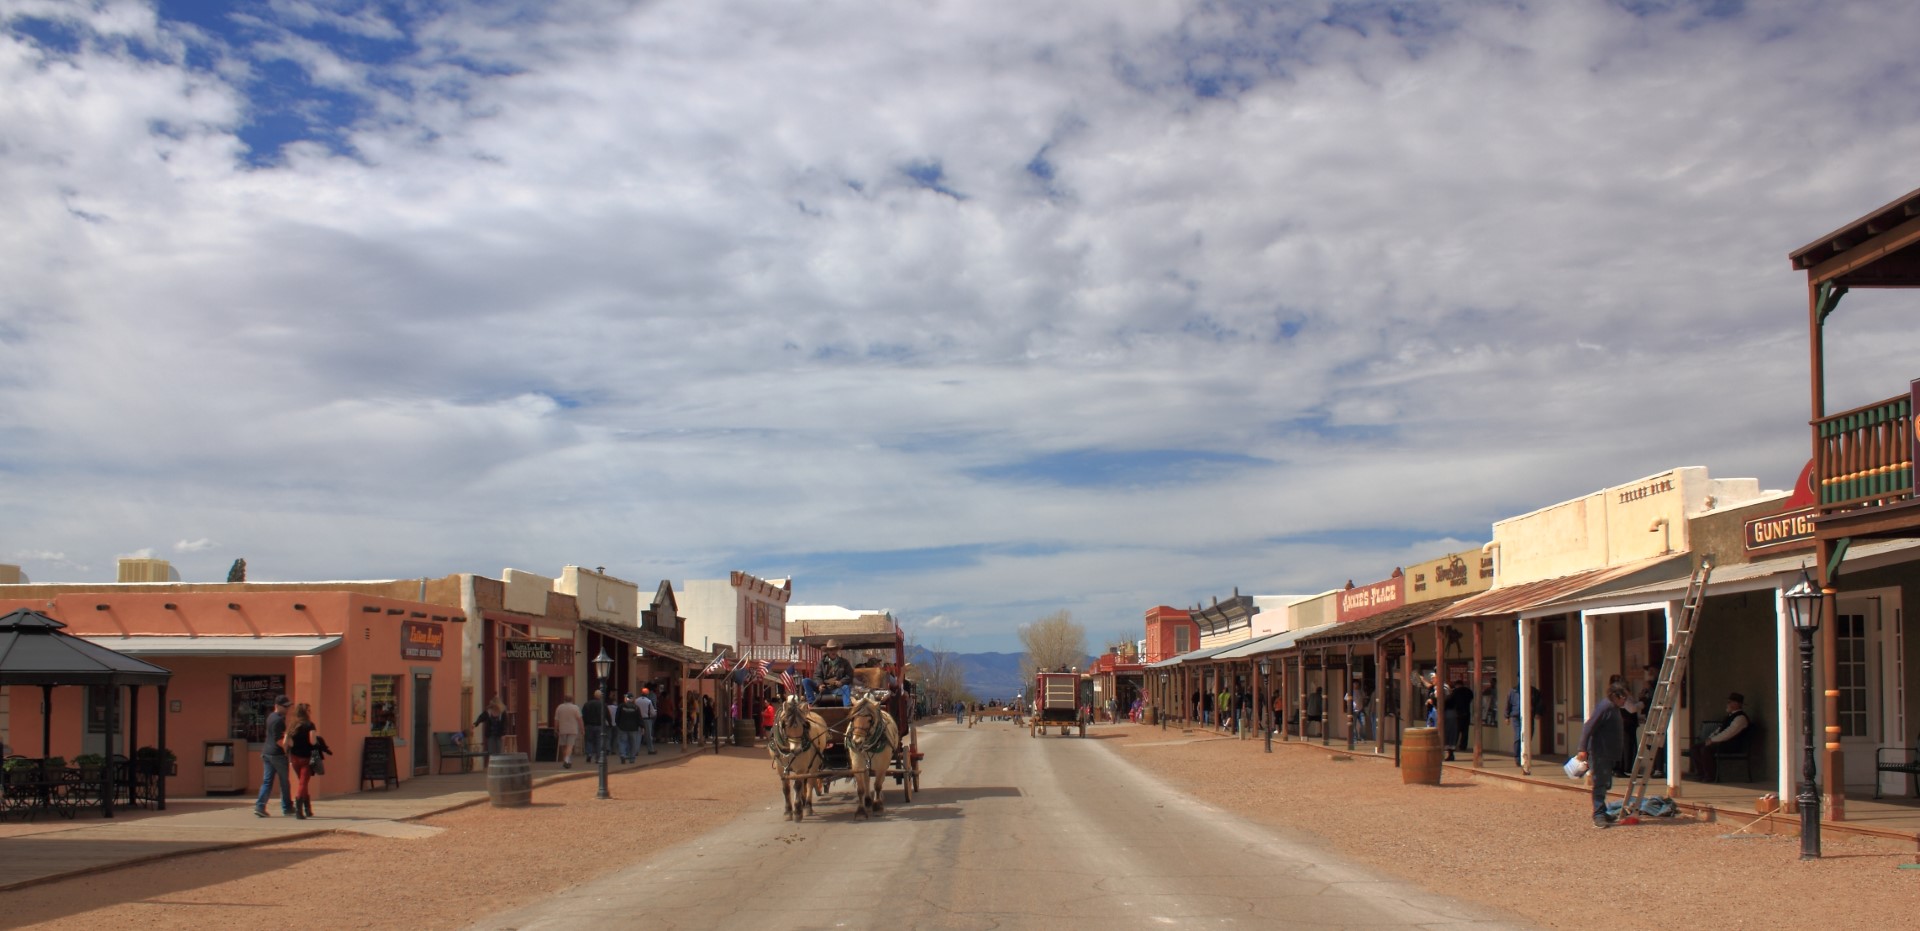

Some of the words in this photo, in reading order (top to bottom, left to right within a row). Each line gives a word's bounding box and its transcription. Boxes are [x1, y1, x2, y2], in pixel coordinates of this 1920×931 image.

[1754, 514, 1816, 543] GUNFIGH
[1343, 589, 1369, 612] ANNIE'S
[1371, 584, 1396, 606] PLACE
[507, 650, 552, 659] UNDERTAKERS
